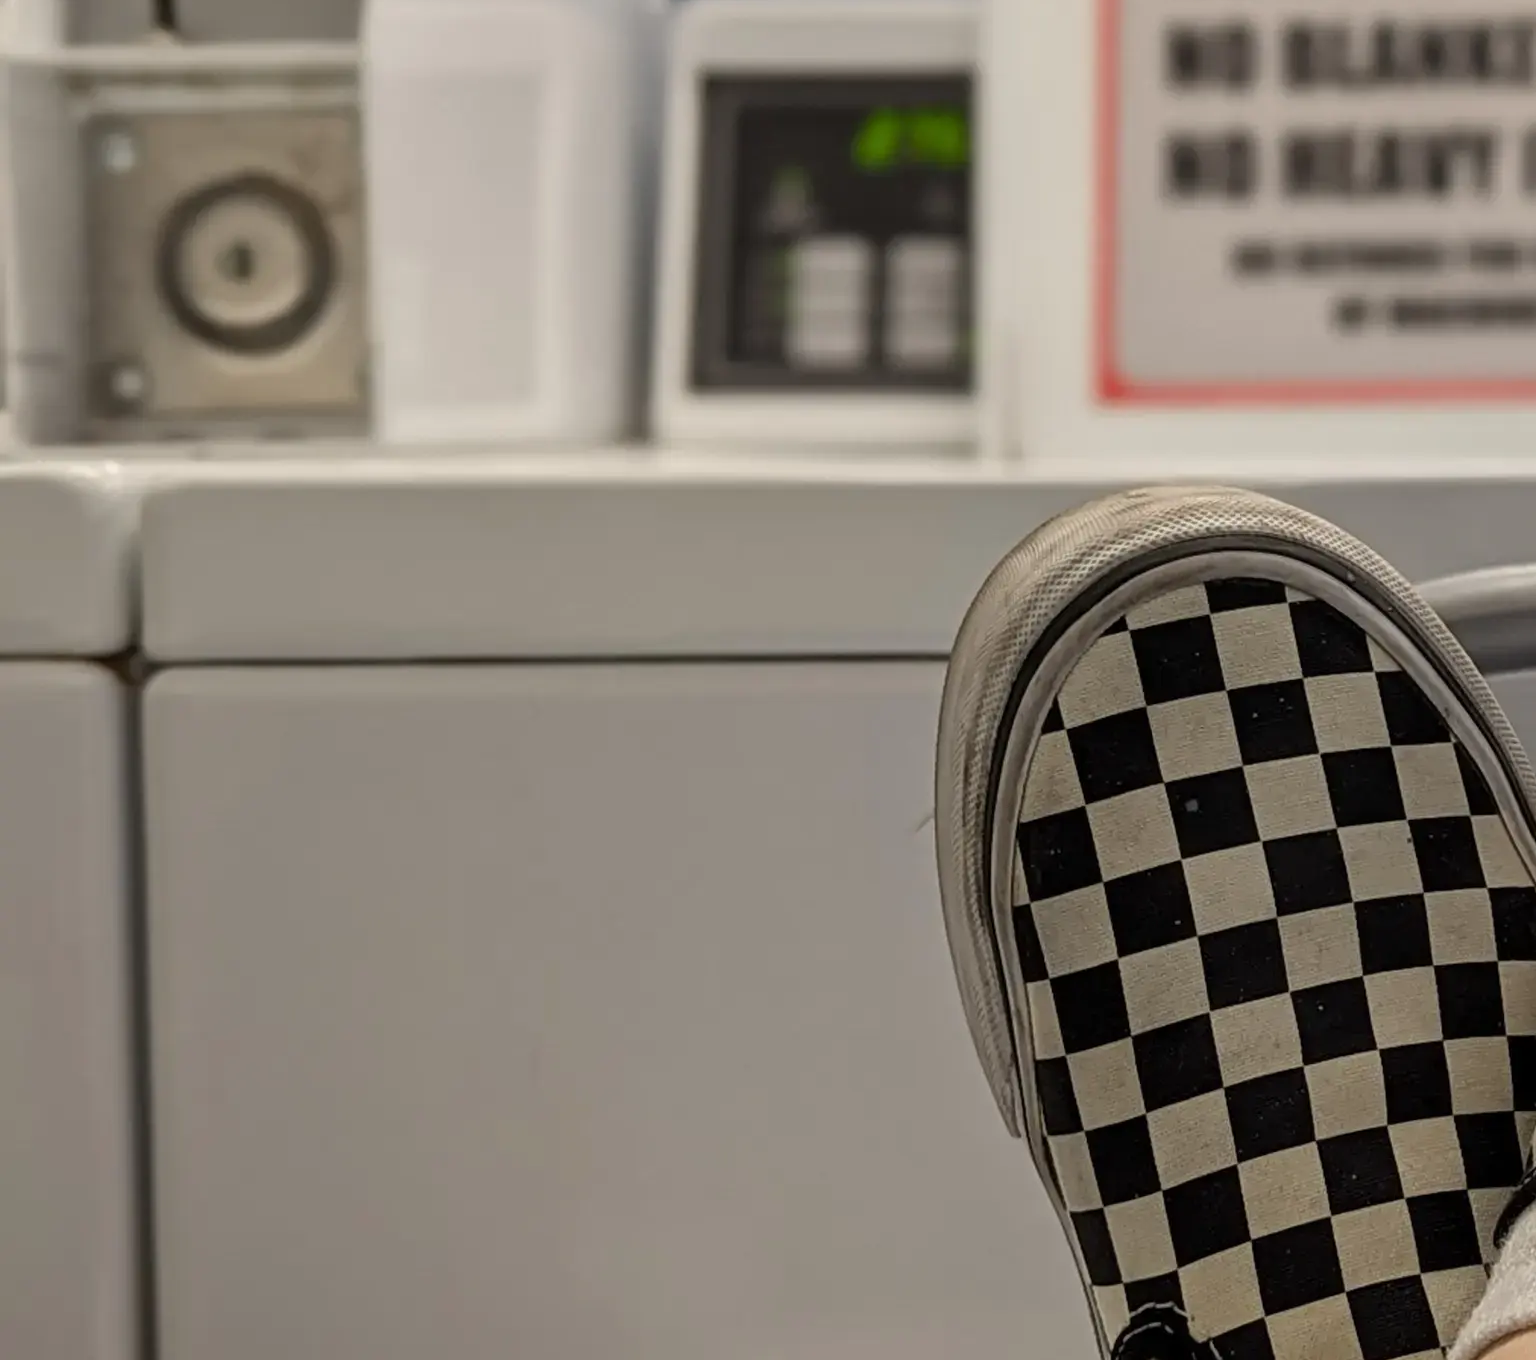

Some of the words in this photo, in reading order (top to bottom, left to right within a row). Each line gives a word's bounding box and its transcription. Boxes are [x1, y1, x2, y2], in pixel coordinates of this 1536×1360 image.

[1165, 22, 1260, 93] NO
[1163, 129, 1260, 202] NO
[1280, 127, 1499, 201] HEAVY
